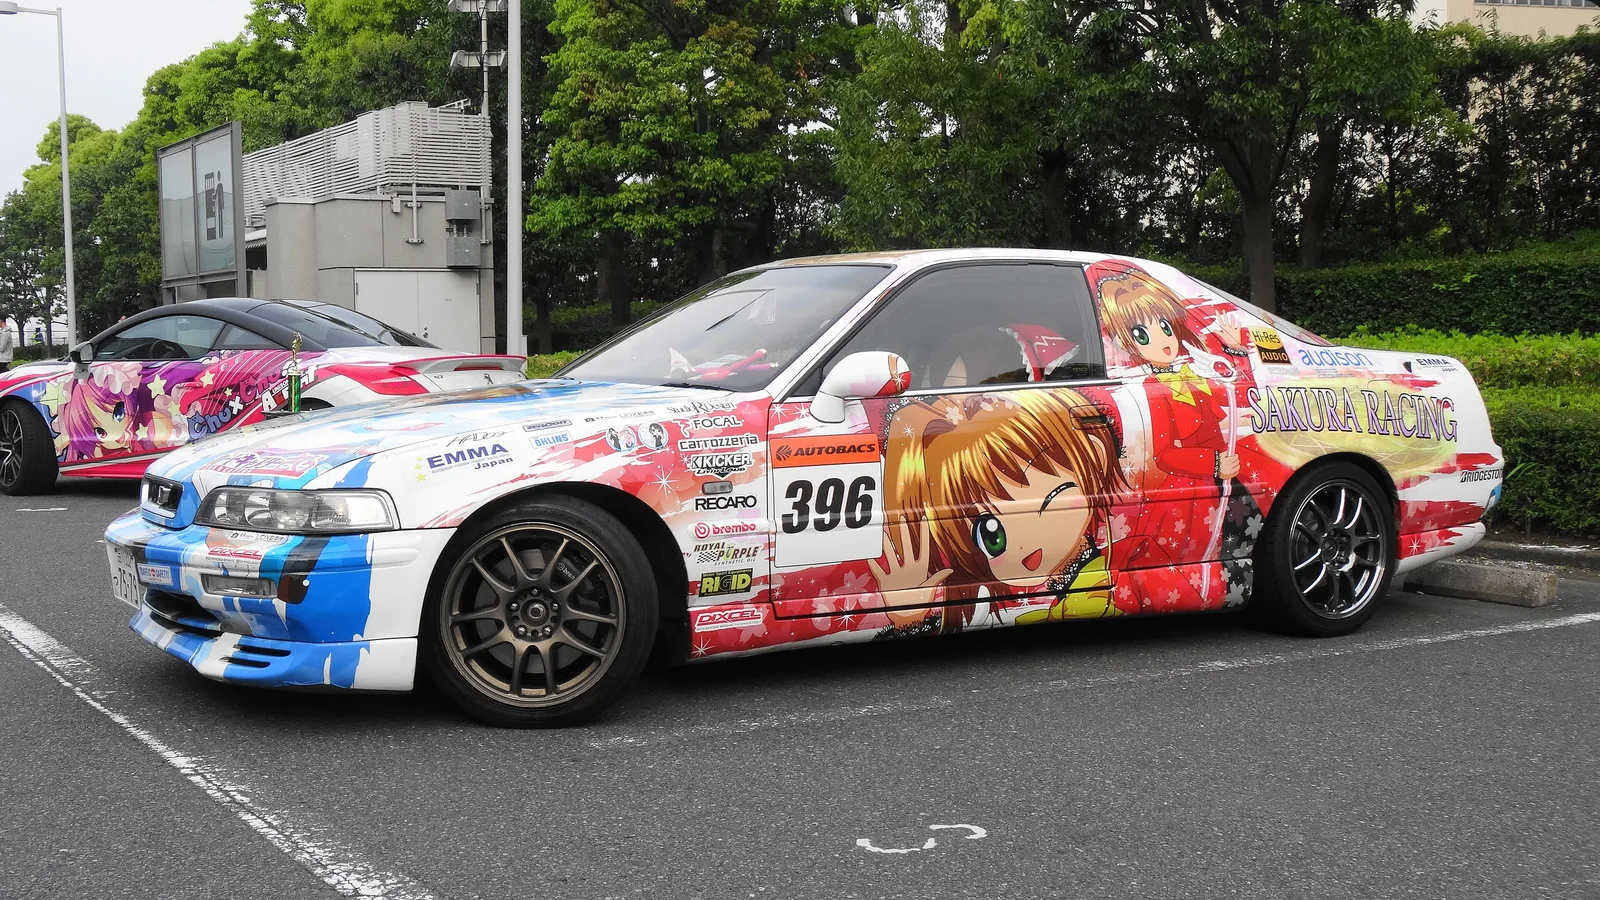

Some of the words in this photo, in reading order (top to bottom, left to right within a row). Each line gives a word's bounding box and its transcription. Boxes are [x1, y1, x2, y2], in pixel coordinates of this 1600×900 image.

[1251, 330, 1281, 344] Hi-Res
[1261, 351, 1288, 361] AUDIO
[1297, 348, 1374, 366] audison
[1416, 358, 1451, 366] EMMA
[1246, 386, 1362, 434] SAKURA
[1361, 390, 1458, 442] RACING
[693, 416, 740, 429] FOCAL
[679, 434, 758, 450] carrozzeria
[426, 443, 508, 469] EMMA
[793, 444, 876, 457] AUTOBACS
[474, 456, 514, 470] Japan
[702, 453, 752, 469] KICKER
[694, 495, 758, 511] RECARO
[781, 475, 876, 534] 396
[711, 521, 757, 535] brembo
[693, 541, 726, 553] ROYAL
[714, 559, 744, 567] SYNTHETIC
[700, 573, 751, 593] RIGID
[698, 609, 761, 623] DIXCEL
